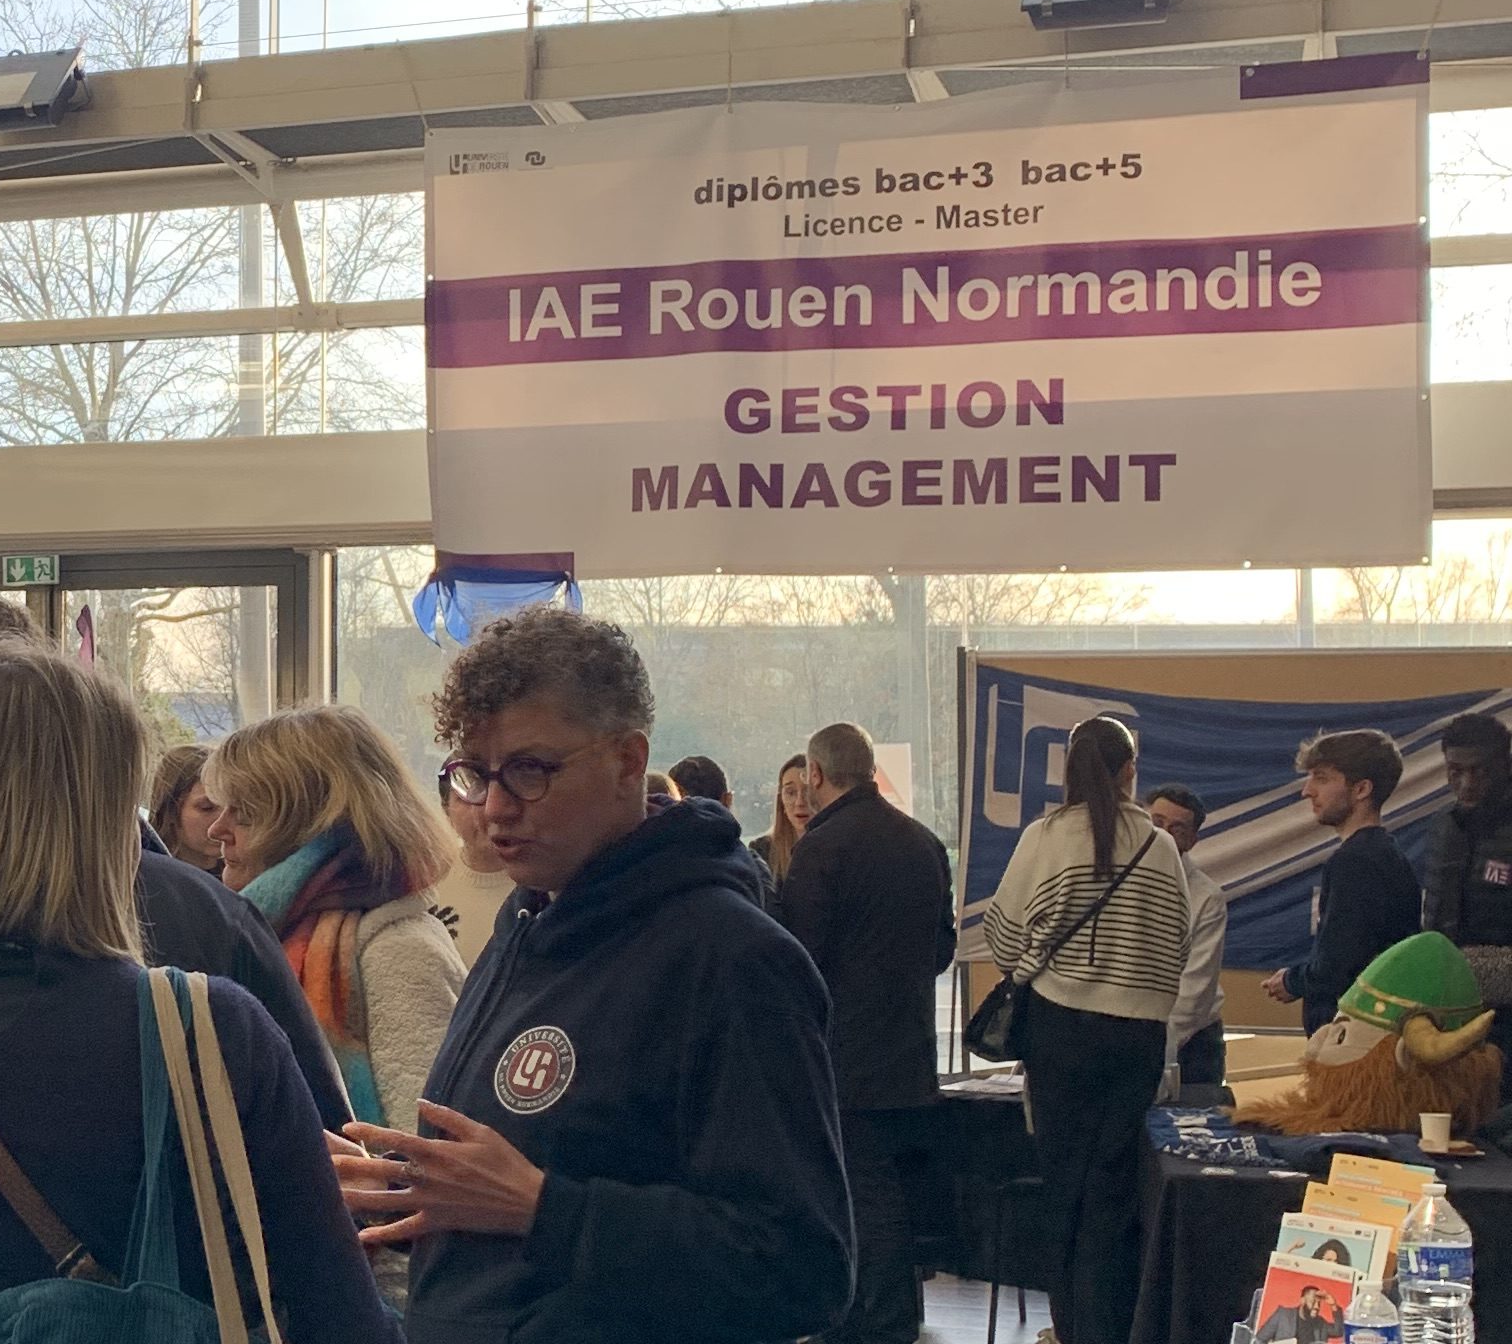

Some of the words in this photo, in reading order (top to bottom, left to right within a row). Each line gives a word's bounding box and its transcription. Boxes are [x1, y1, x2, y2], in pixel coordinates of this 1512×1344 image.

[693, 172, 861, 208] diplômes
[874, 161, 994, 194] bac+3
[1020, 153, 1143, 186] bac+5
[783, 212, 903, 238] Licence
[935, 202, 1045, 230] Master
[508, 282, 623, 343] IAE
[649, 279, 873, 335] Rouen
[901, 249, 1323, 324] Normandie
[724, 377, 1065, 435] GESTION
[631, 453, 1177, 513] MANAGEMENT
